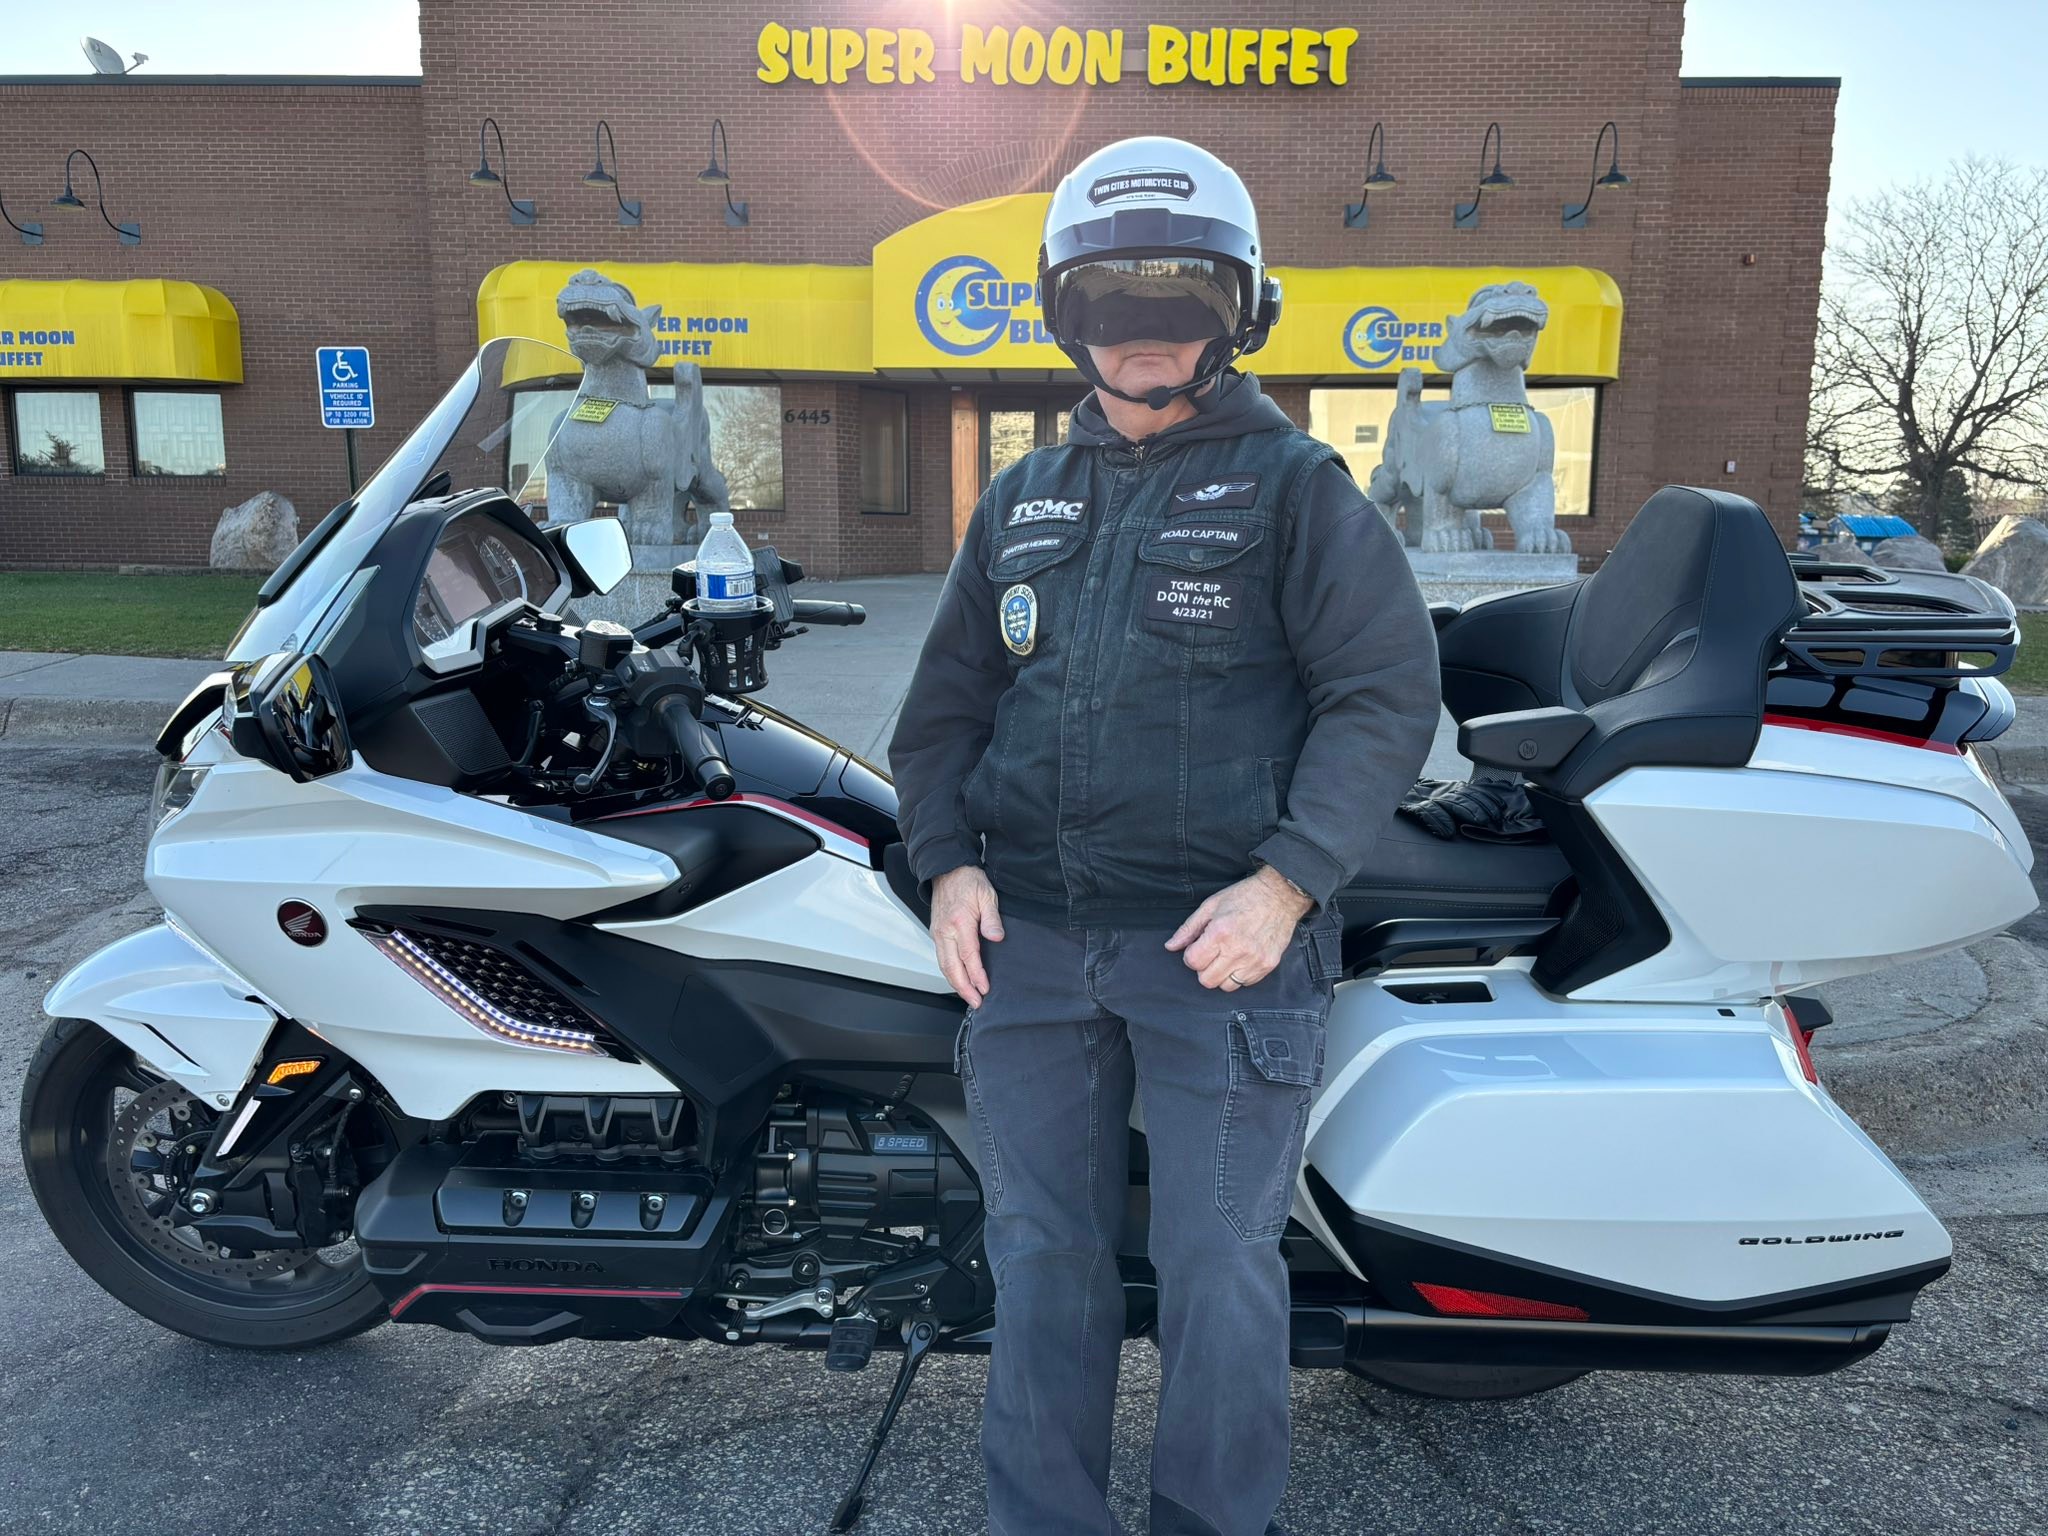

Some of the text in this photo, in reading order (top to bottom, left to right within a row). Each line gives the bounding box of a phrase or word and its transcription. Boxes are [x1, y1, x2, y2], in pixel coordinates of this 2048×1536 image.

[757, 22, 1360, 86] SUPER MOON BUFFET
[1093, 178, 1189, 196] TWIN CITIES MOTORCYCLE CLUB
[687, 317, 748, 333] MOON
[1376, 322, 1442, 338] SUPER
[19, 331, 75, 345] MOON
[784, 409, 831, 424] 6445
[1011, 499, 1084, 521] TCMC
[1160, 529, 1239, 541] ROAD CAPTAIN
[1002, 539, 1060, 558] CHARTER MEMBER
[1170, 580, 1221, 593] TCMC RIP
[1156, 590, 1232, 609] DON the RC
[1172, 607, 1213, 620] 4/23/21
[887, 1137, 925, 1148] SPEED
[1738, 1229, 1905, 1246] GOLDWING
[487, 1258, 607, 1273] HONDA
